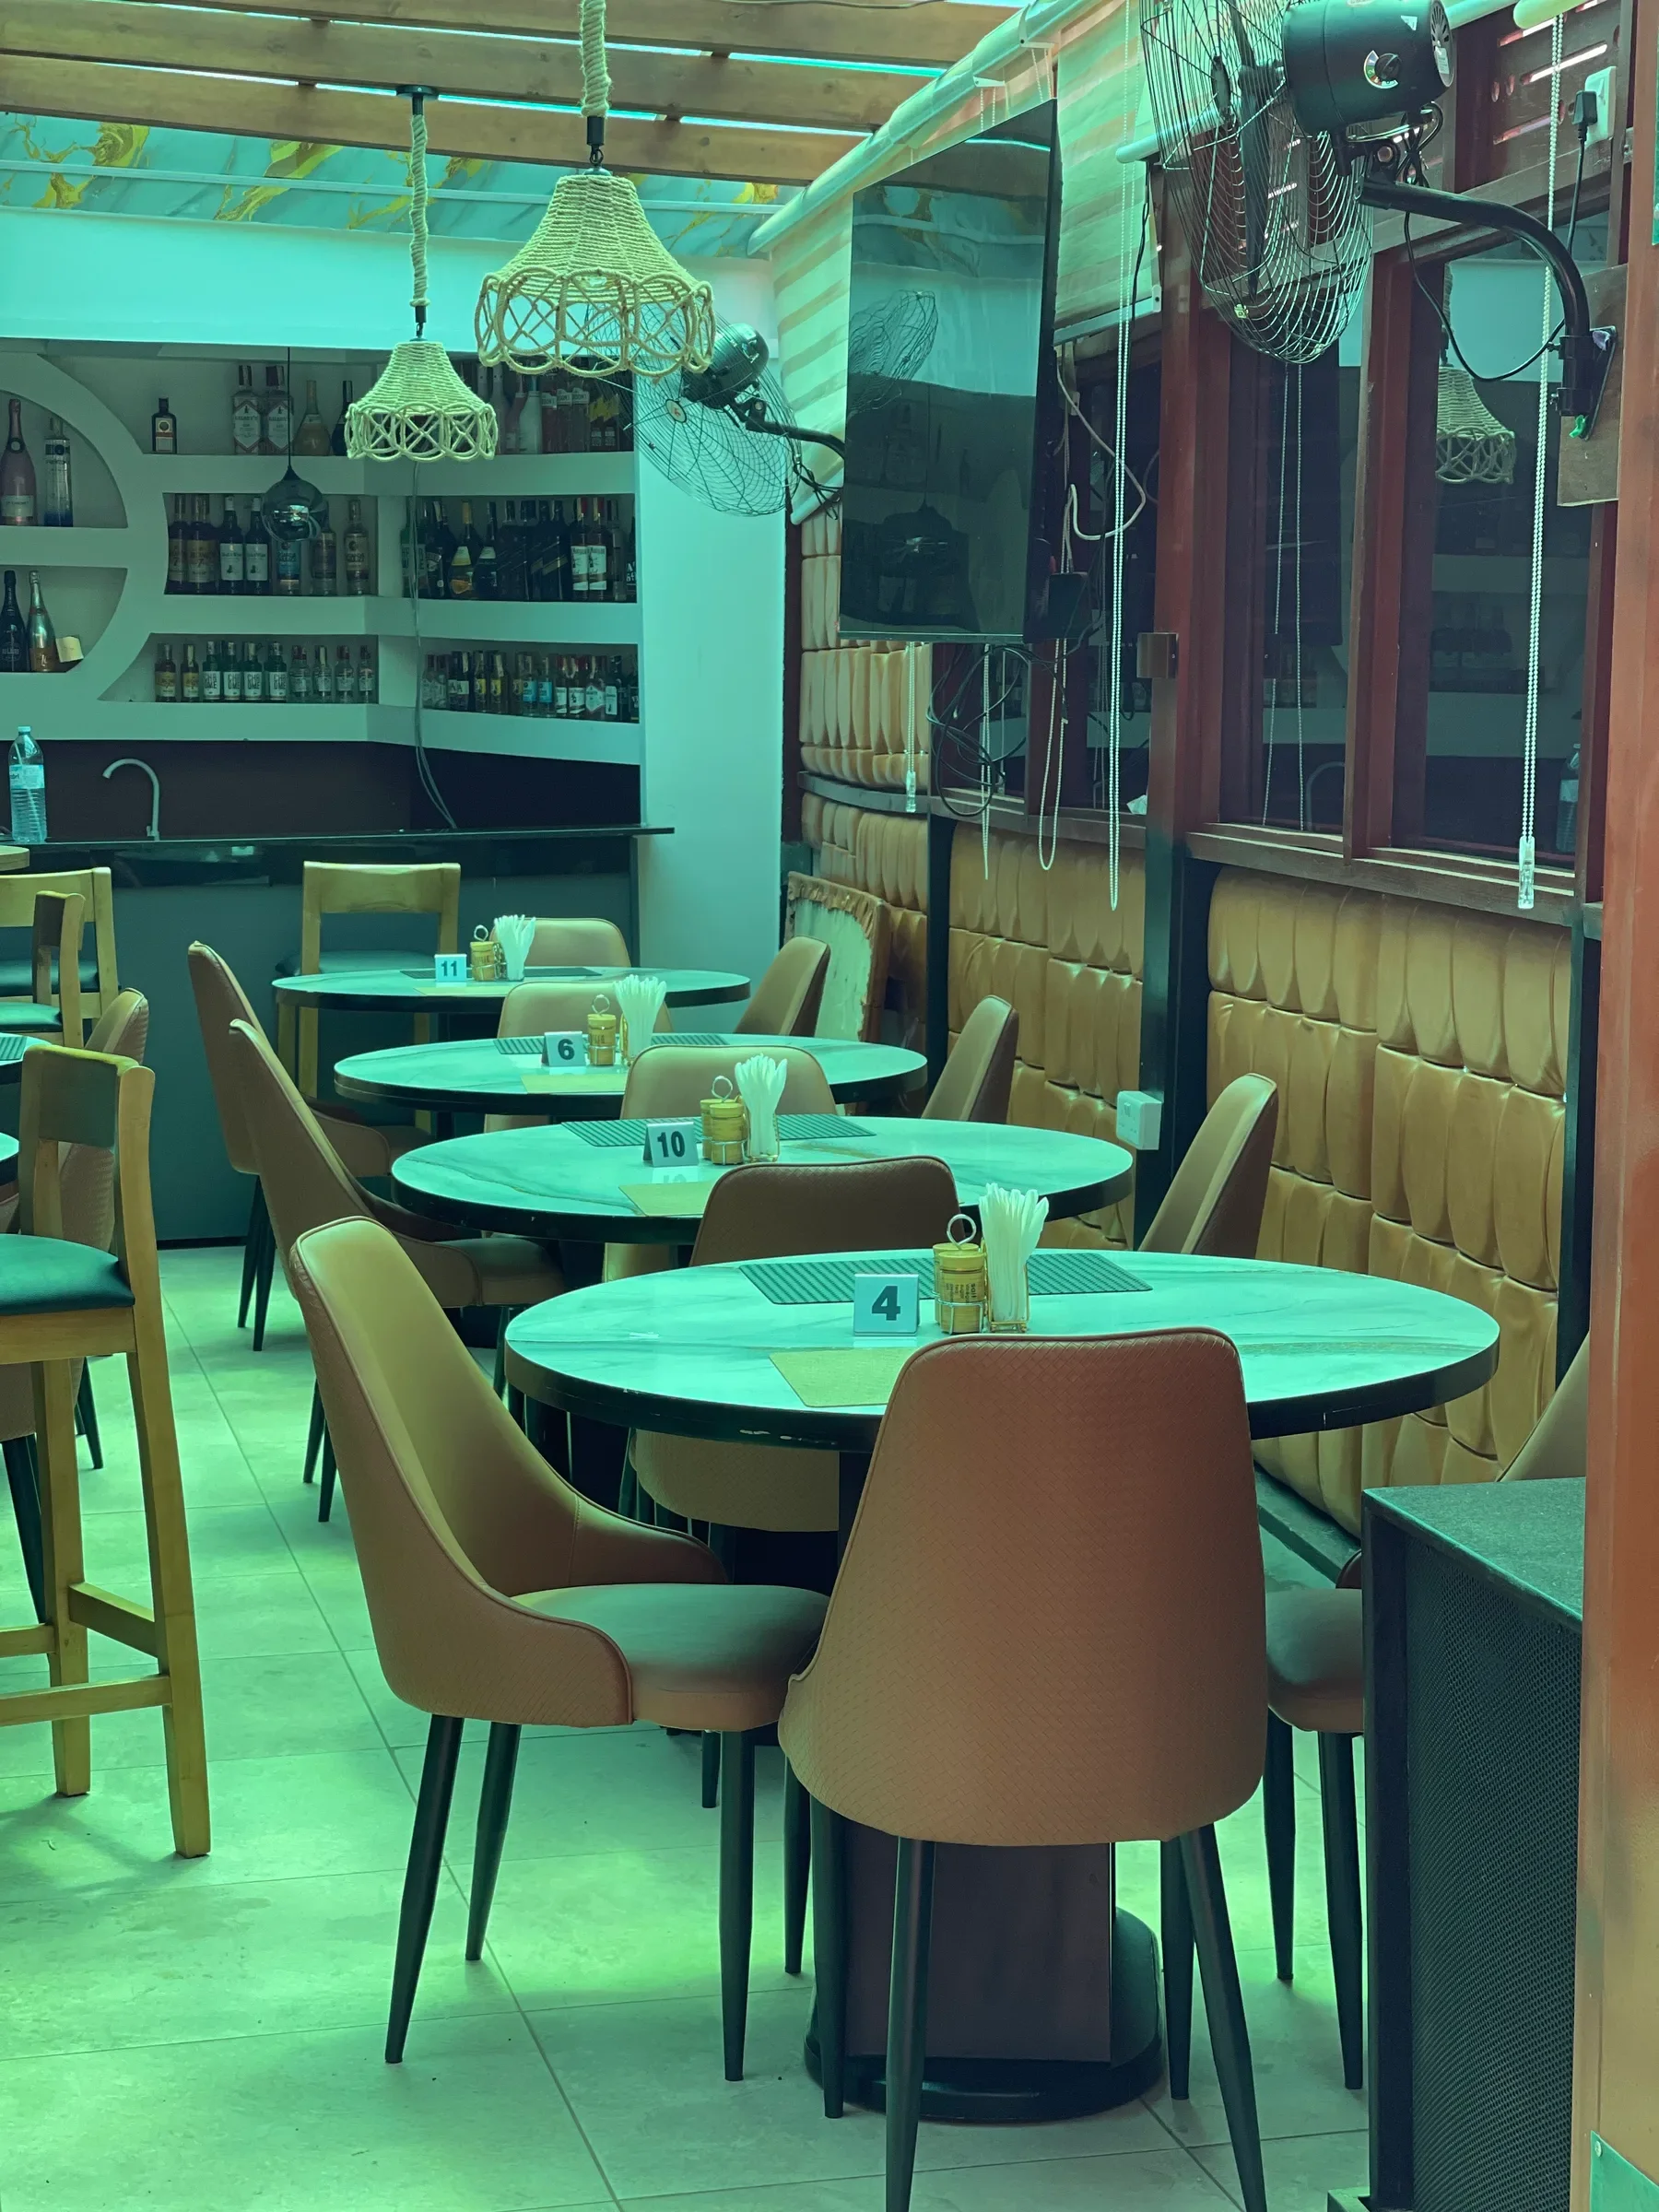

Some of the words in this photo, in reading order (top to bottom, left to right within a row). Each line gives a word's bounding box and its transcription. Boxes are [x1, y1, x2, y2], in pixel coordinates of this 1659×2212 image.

[441, 960, 458, 977] 11
[557, 1038, 575, 1061] 6
[656, 1130, 686, 1159] 10
[871, 1285, 901, 1322] 4
